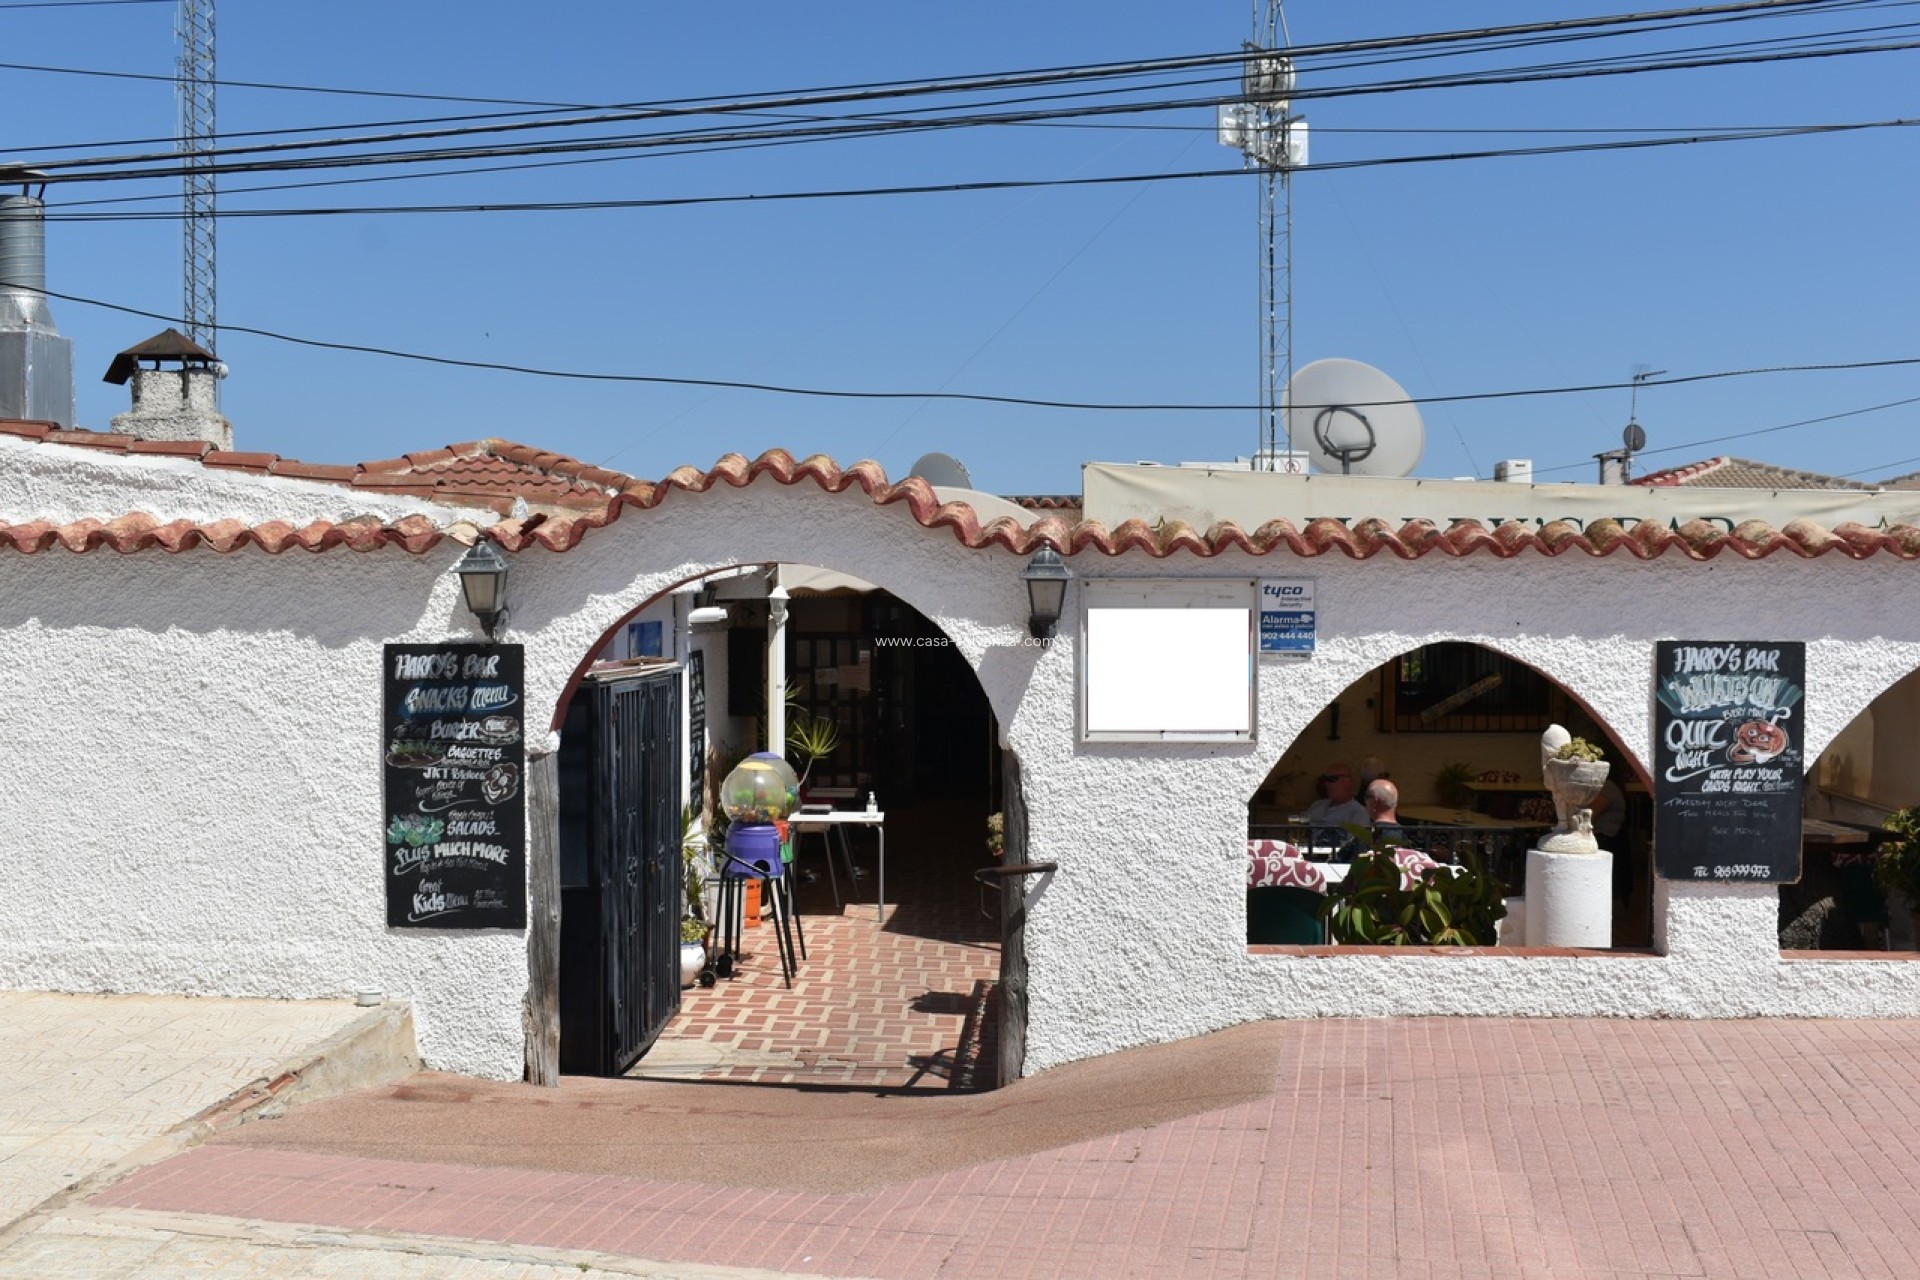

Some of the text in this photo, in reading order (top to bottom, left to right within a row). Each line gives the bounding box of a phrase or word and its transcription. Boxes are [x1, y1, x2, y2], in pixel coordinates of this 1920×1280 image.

[1263, 585, 1303, 597] tyco
[1263, 615, 1299, 624] Alarma
[462, 654, 500, 679] BAR
[1673, 644, 1781, 674] HARRY'S BAR
[1665, 720, 1727, 753] QUIZ
[423, 767, 448, 779] JKT
[433, 841, 471, 858] MUCH
[472, 841, 510, 865] MORE
[413, 892, 445, 914] Kids
